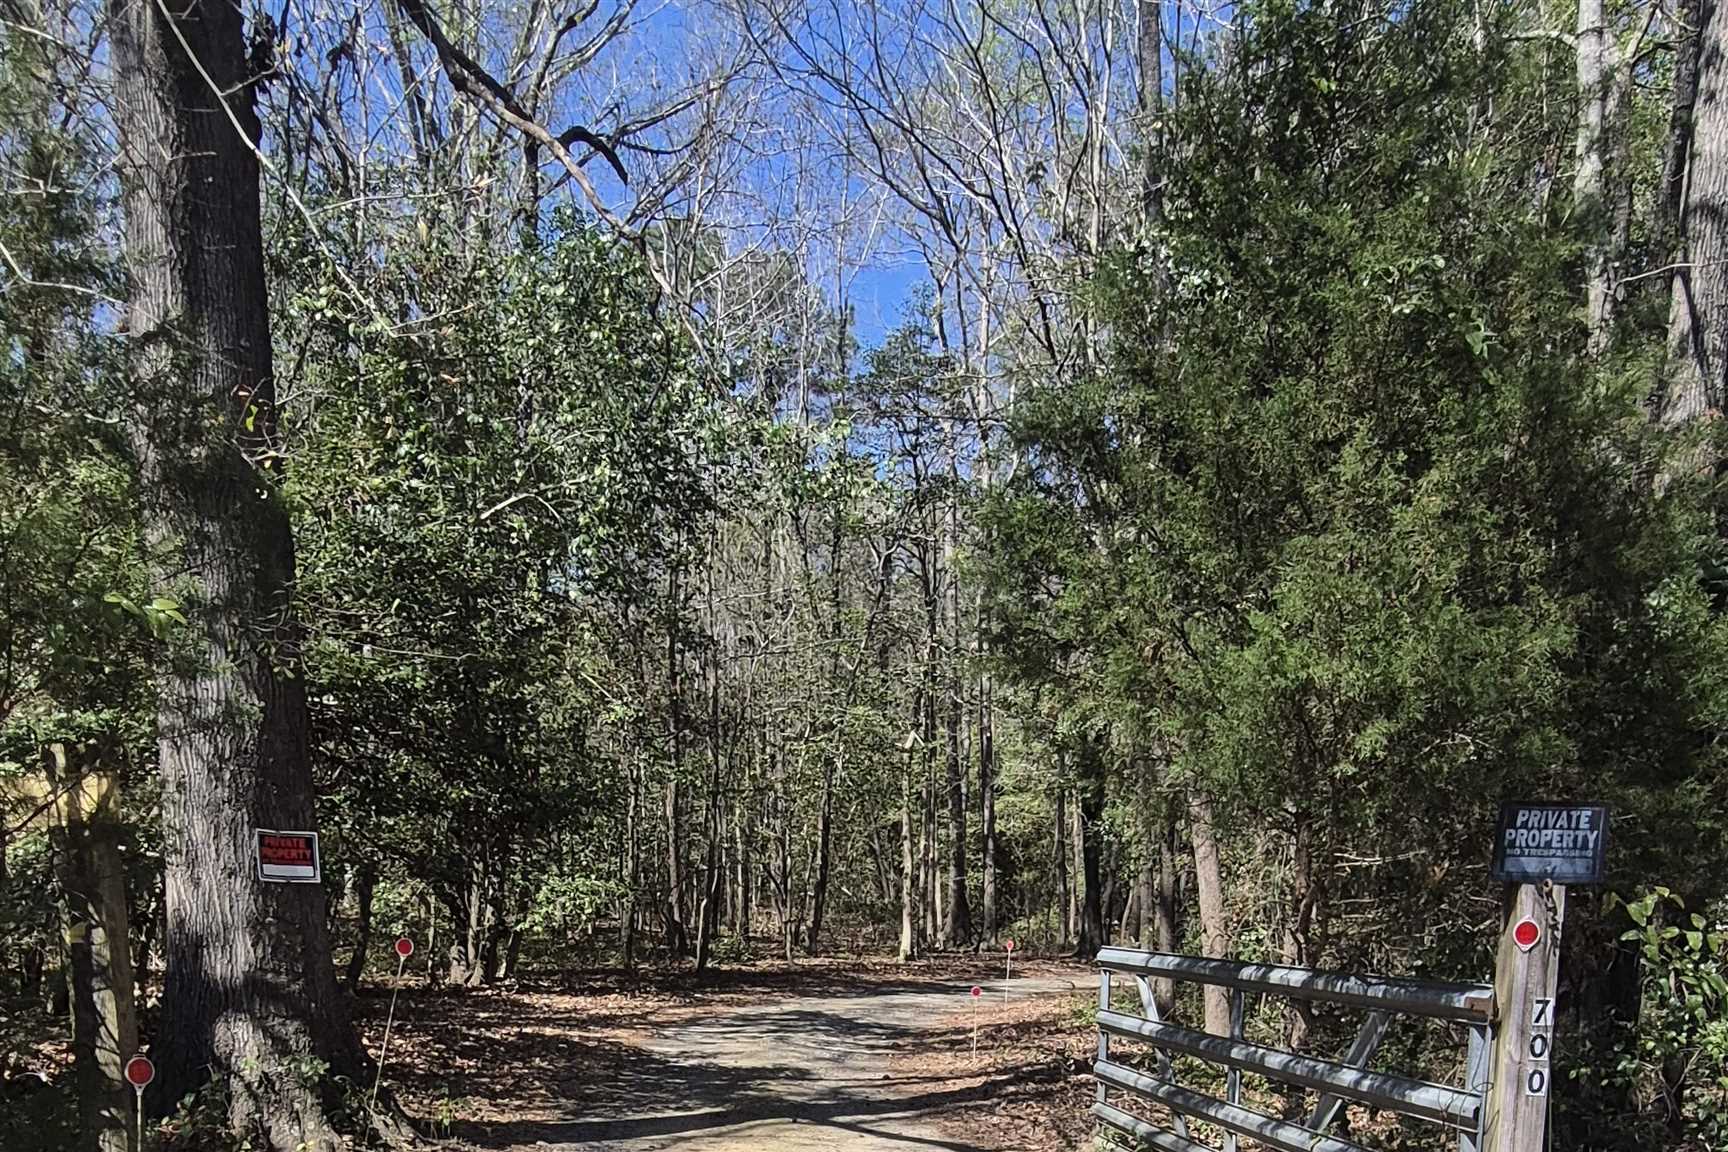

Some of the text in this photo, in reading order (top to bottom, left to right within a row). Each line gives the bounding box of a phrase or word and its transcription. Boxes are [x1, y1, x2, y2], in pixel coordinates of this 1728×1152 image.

[1516, 810, 1592, 829] PRIVATE
[264, 836, 305, 848] PRIVATE
[1504, 829, 1598, 849] PROPERTY
[261, 847, 311, 860] PROPERTY
[1528, 999, 1551, 1093] 700
